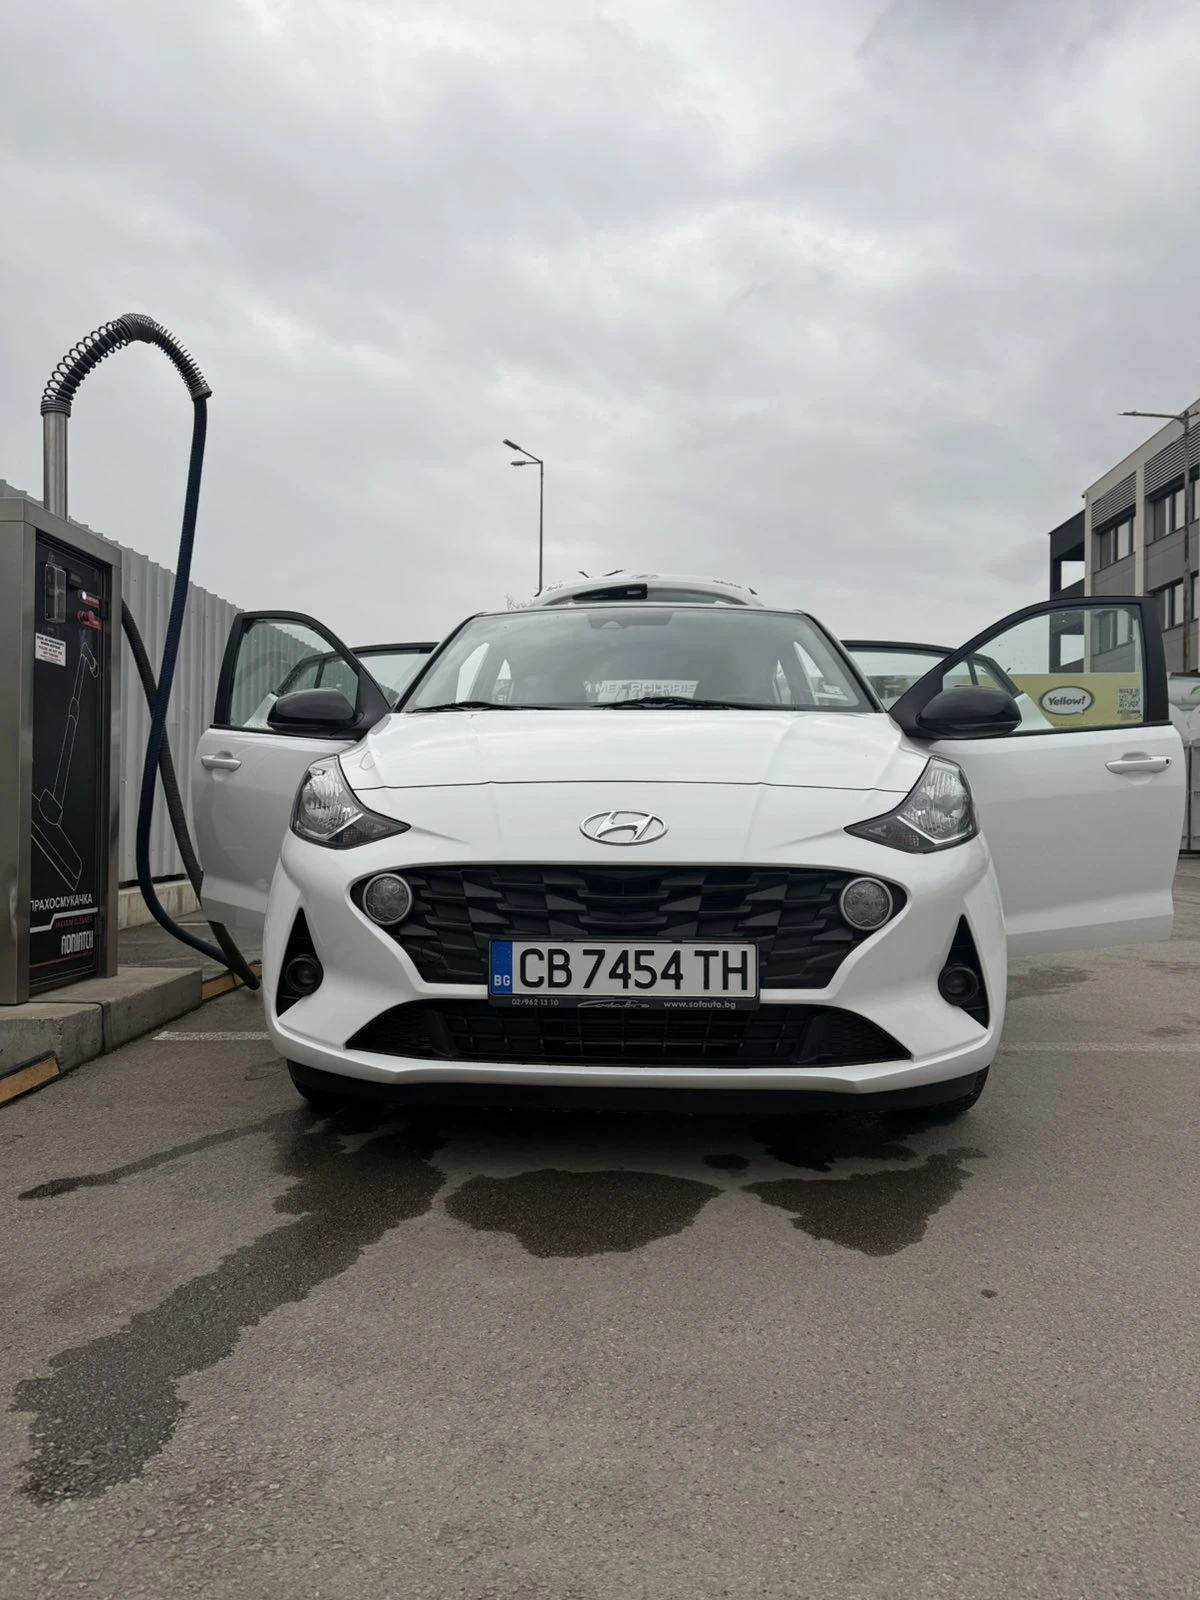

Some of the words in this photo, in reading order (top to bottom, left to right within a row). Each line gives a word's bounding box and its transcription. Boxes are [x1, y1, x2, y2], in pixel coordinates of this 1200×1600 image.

[1048, 695, 1086, 707] Yellow!
[519, 948, 572, 988] CB
[582, 949, 684, 990] 7454
[693, 950, 748, 990] TH
[494, 974, 511, 987] BG
[663, 999, 737, 1010] www.sofauto.bg
